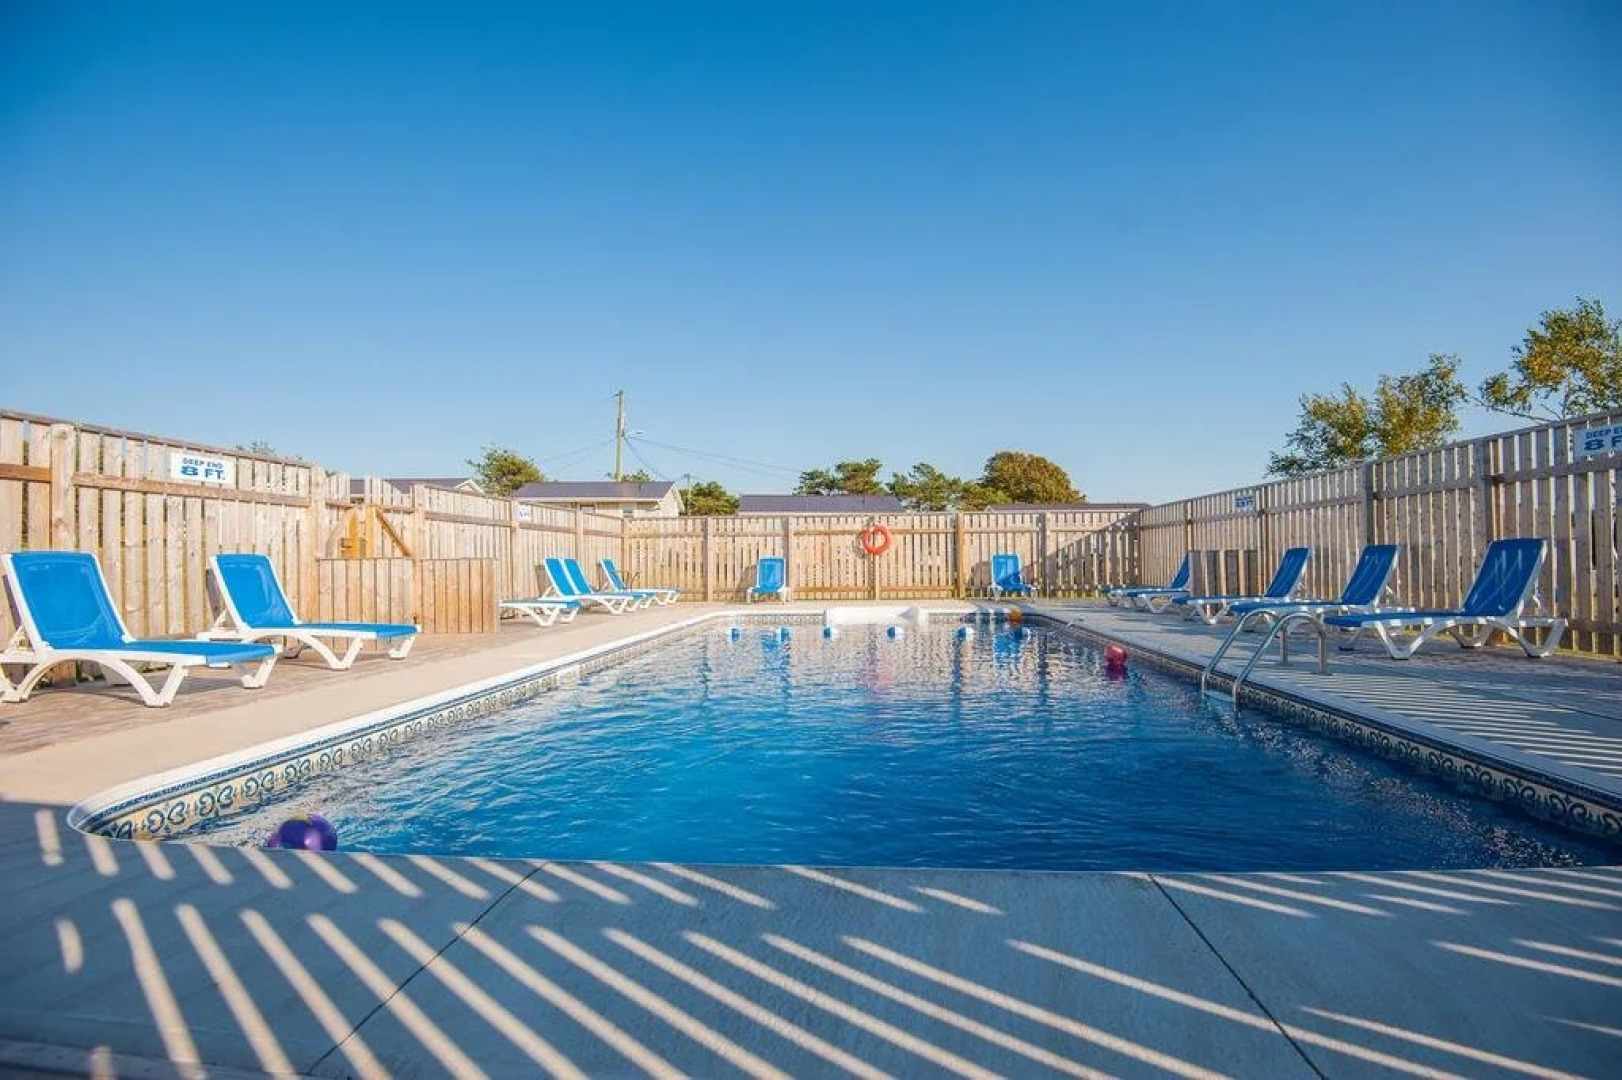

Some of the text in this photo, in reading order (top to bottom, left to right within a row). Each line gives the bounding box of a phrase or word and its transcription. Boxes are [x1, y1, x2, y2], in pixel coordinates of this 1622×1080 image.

[1585, 428, 1612, 439] DEEP
[1584, 438, 1604, 451] 8
[182, 457, 205, 466] DEEP
[181, 466, 199, 476] 8
